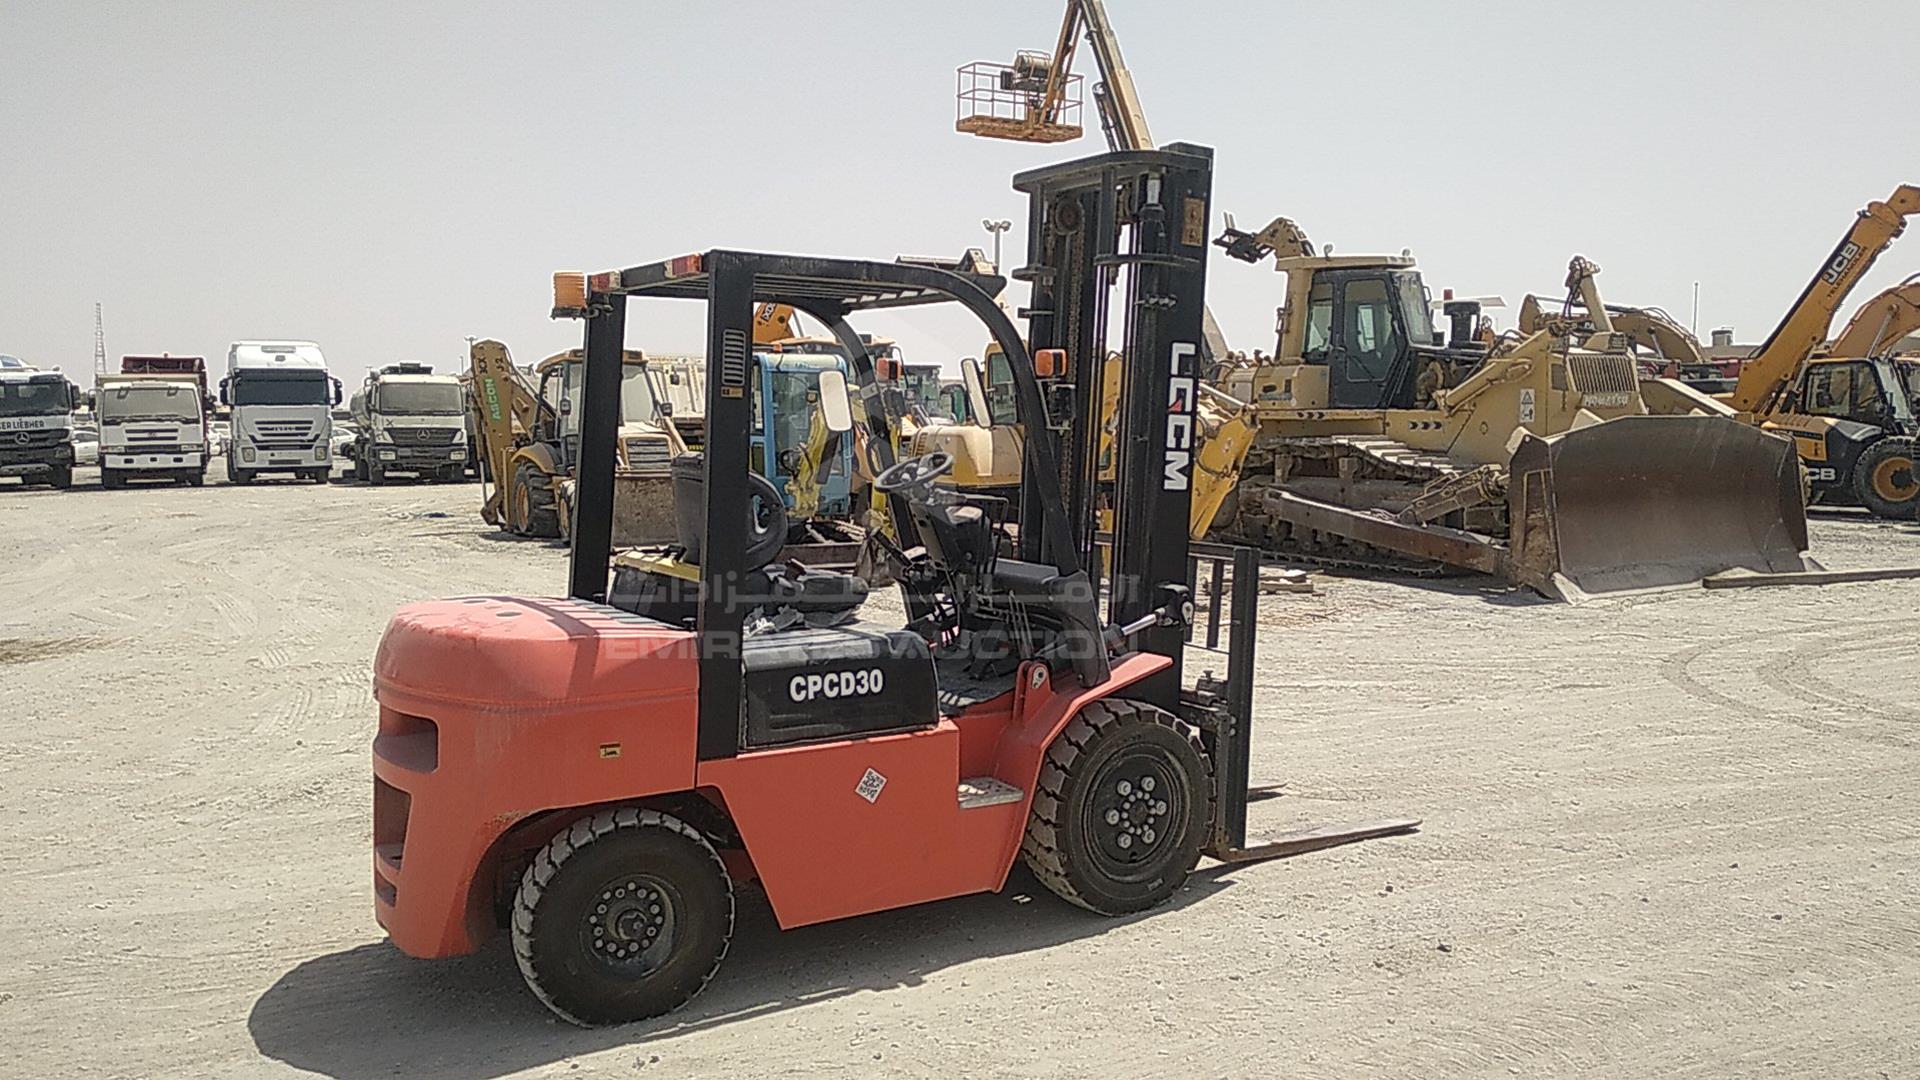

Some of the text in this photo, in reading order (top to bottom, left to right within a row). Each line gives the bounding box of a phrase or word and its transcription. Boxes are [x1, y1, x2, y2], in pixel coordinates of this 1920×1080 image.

[1823, 242, 1860, 283] JCB
[1807, 468, 1836, 481] CB
[789, 668, 884, 702] CPCD30
